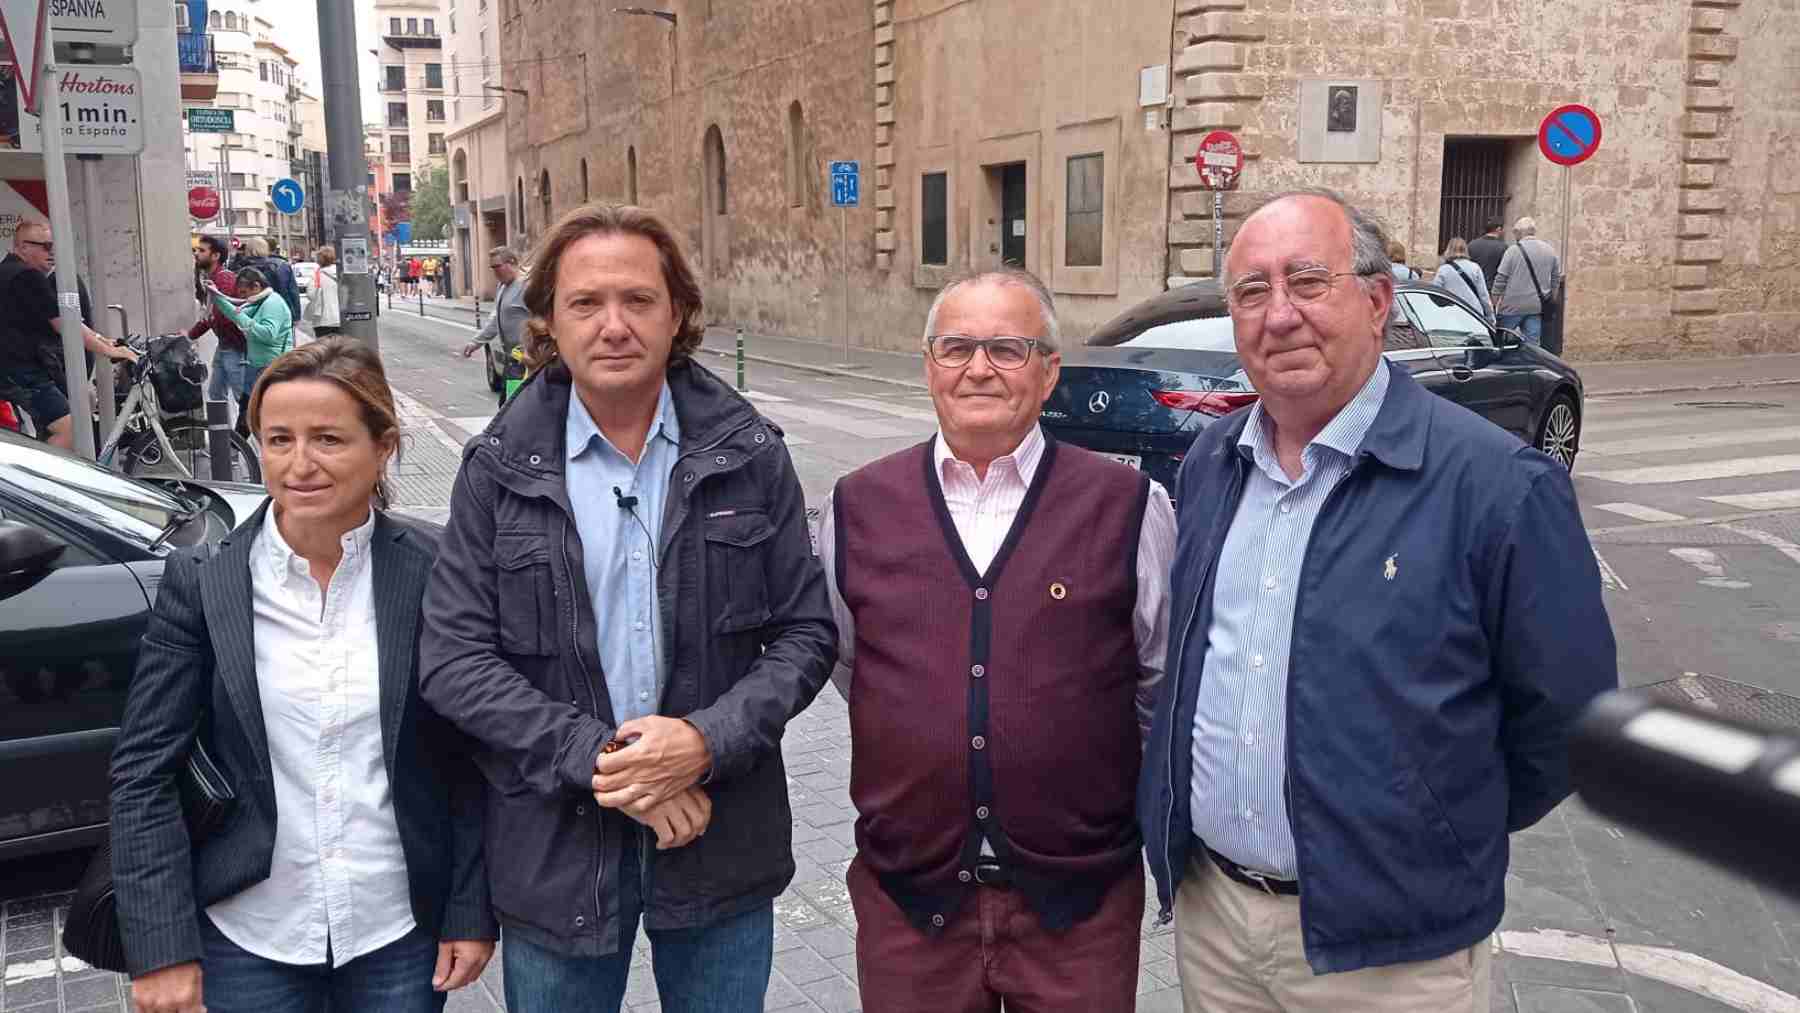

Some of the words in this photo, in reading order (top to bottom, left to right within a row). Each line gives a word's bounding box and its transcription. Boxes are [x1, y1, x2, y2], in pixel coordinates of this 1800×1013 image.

[49, 0, 105, 18] SPANYA
[59, 71, 135, 95] Hortons
[78, 103, 137, 123] min.
[79, 125, 127, 138] España
